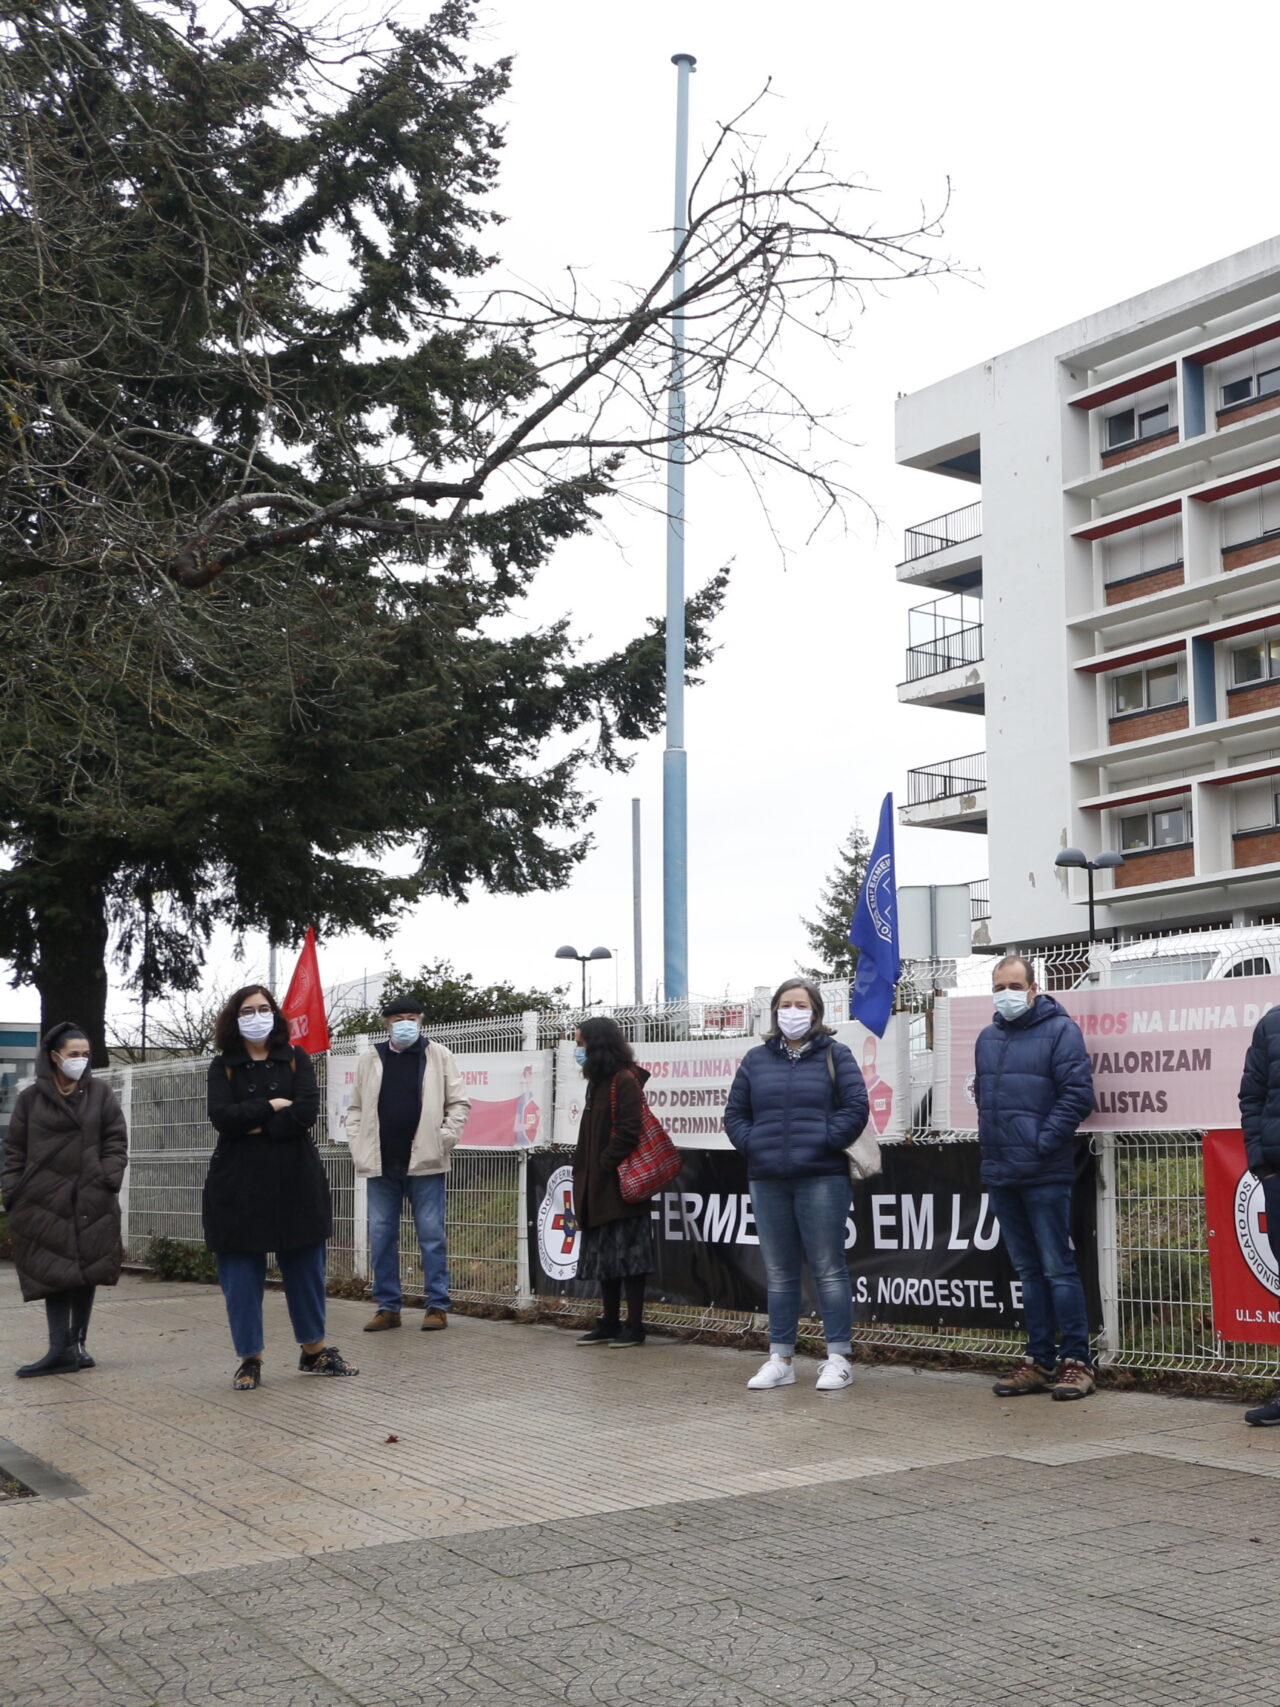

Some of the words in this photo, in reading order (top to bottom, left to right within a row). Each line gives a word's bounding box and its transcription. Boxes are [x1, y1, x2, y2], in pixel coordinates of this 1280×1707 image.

[1132, 1010, 1163, 1034] NA
[1168, 1005, 1238, 1032] LINHA
[672, 1061, 689, 1078] NA
[693, 1059, 732, 1078] LINHA
[670, 1089, 728, 1107] DOENTES
[1237, 1180, 1252, 1213] DOS
[871, 1193, 934, 1250] EM
[947, 1193, 1000, 1251] LU
[1238, 1218, 1280, 1291] SINDICATO
[877, 1277, 1005, 1313] NORDESTE,
[1236, 1309, 1266, 1323] U.L.S.
